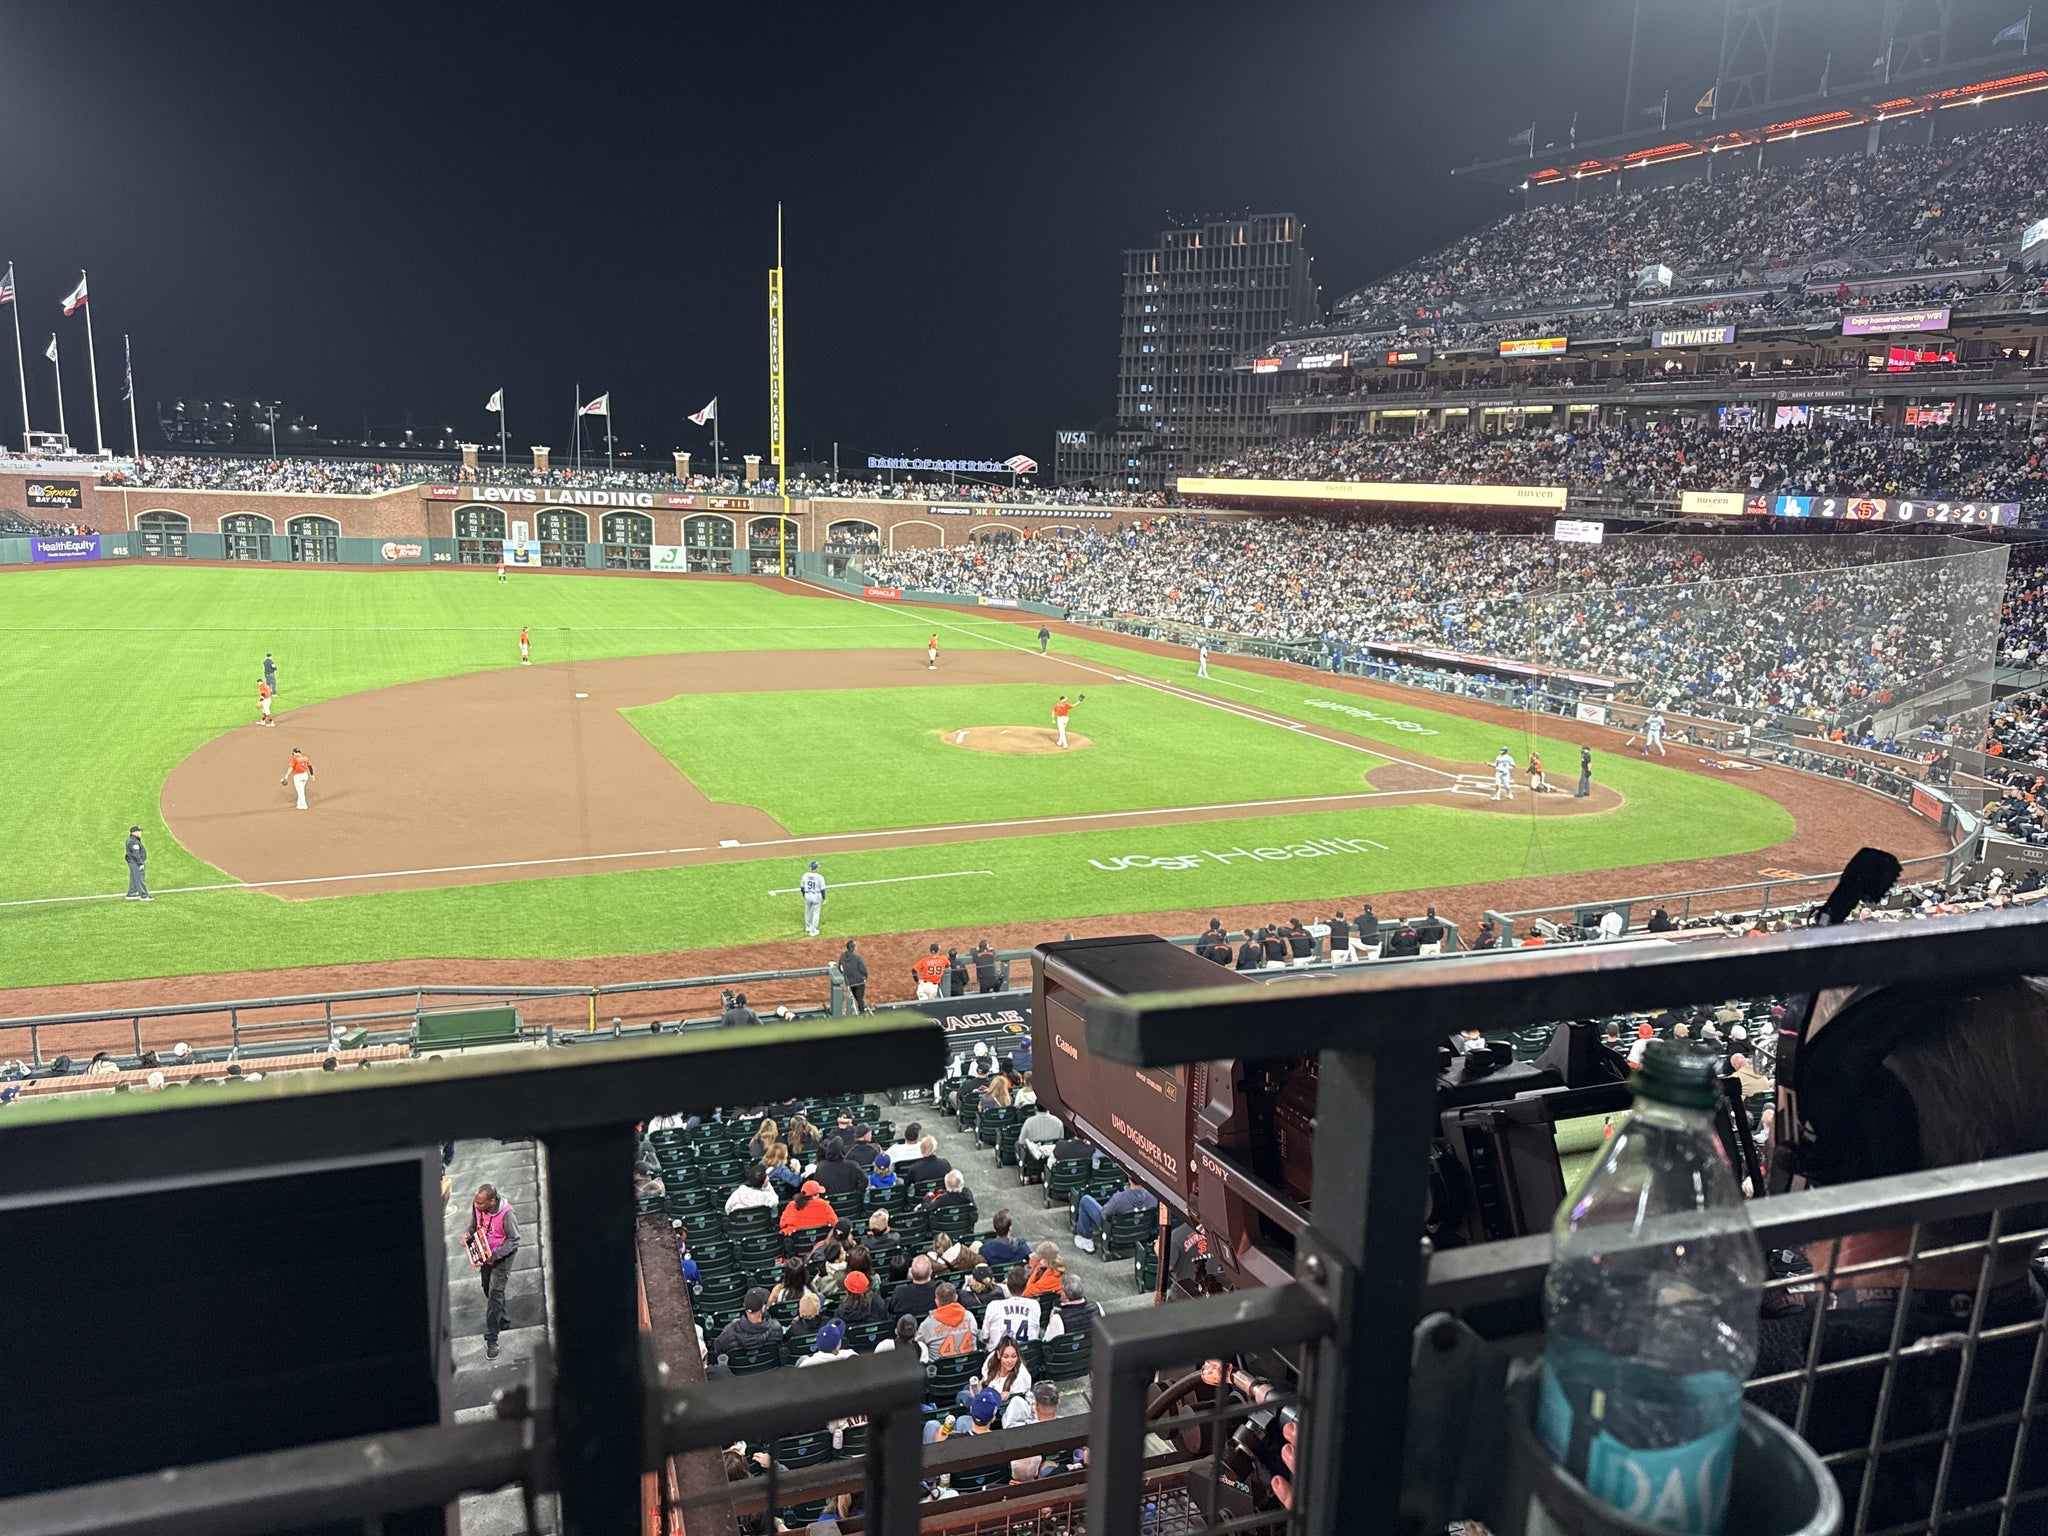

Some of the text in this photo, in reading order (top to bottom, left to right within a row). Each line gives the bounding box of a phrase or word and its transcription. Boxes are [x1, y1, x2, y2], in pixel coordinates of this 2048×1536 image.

[1851, 318, 1869, 326] Enjoy
[1661, 328, 1725, 346] CUTWATER
[1059, 432, 1086, 444] VISA
[868, 457, 1002, 473] BANK OF AMERICA
[43, 485, 79, 498] Sports
[544, 489, 653, 506] LANDING
[1517, 489, 1553, 499] nuveen
[1697, 496, 1729, 505] nuveen
[1758, 496, 1767, 507] 6
[1822, 499, 1835, 517] 2
[1899, 501, 1913, 520] 0
[1927, 508, 1935, 517] B
[1936, 504, 1950, 522] 2
[1953, 508, 1961, 518] S
[1961, 505, 1975, 523] 2
[1990, 506, 2000, 524] 1
[37, 540, 95, 552] HealthEquity
[112, 547, 128, 556] 415
[434, 553, 451, 561] 365
[763, 566, 780, 574] 309
[868, 588, 895, 598] ORACLE
[1201, 837, 1389, 865] Health
[807, 881, 816, 890] 91
[928, 966, 942, 975] 99
[1055, 1034, 1078, 1060] Canon
[903, 1089, 920, 1100] 123
[1166, 1085, 1176, 1100] 4K
[1111, 1113, 1126, 1134] UHD
[1126, 1124, 1162, 1163] DIGISUPER
[1163, 1152, 1177, 1174] 122
[1202, 1155, 1229, 1181] SONY
[1003, 1305, 1030, 1317] BANKS
[1003, 1319, 1028, 1342] 14
[939, 1330, 973, 1357] 44
[1236, 1480, 1250, 1493] 750
